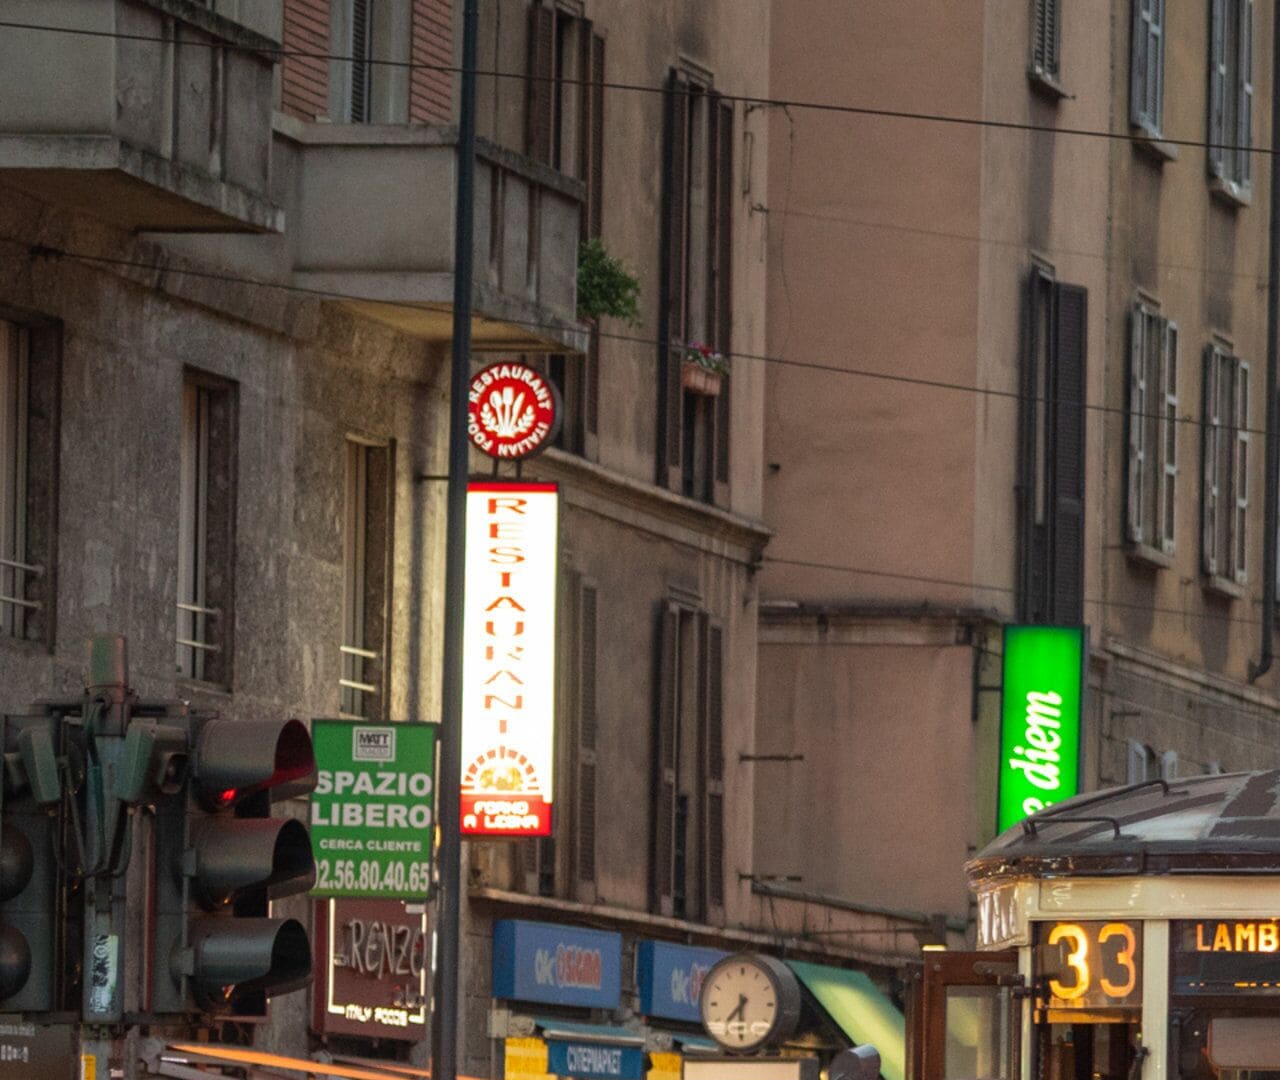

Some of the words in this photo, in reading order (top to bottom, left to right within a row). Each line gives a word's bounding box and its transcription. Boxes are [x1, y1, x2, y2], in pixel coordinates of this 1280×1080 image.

[468, 365, 553, 411] RESTAURANT
[498, 421, 550, 456] ITALIAN
[359, 733, 389, 744] MATT
[1008, 690, 1063, 790] diem
[314, 770, 433, 796] SPAZIO
[311, 802, 432, 828] LIBERO
[319, 839, 363, 851] CERCA
[366, 841, 422, 852] CLIENTE
[348, 918, 427, 981] RENZO
[1047, 923, 1136, 999] 33
